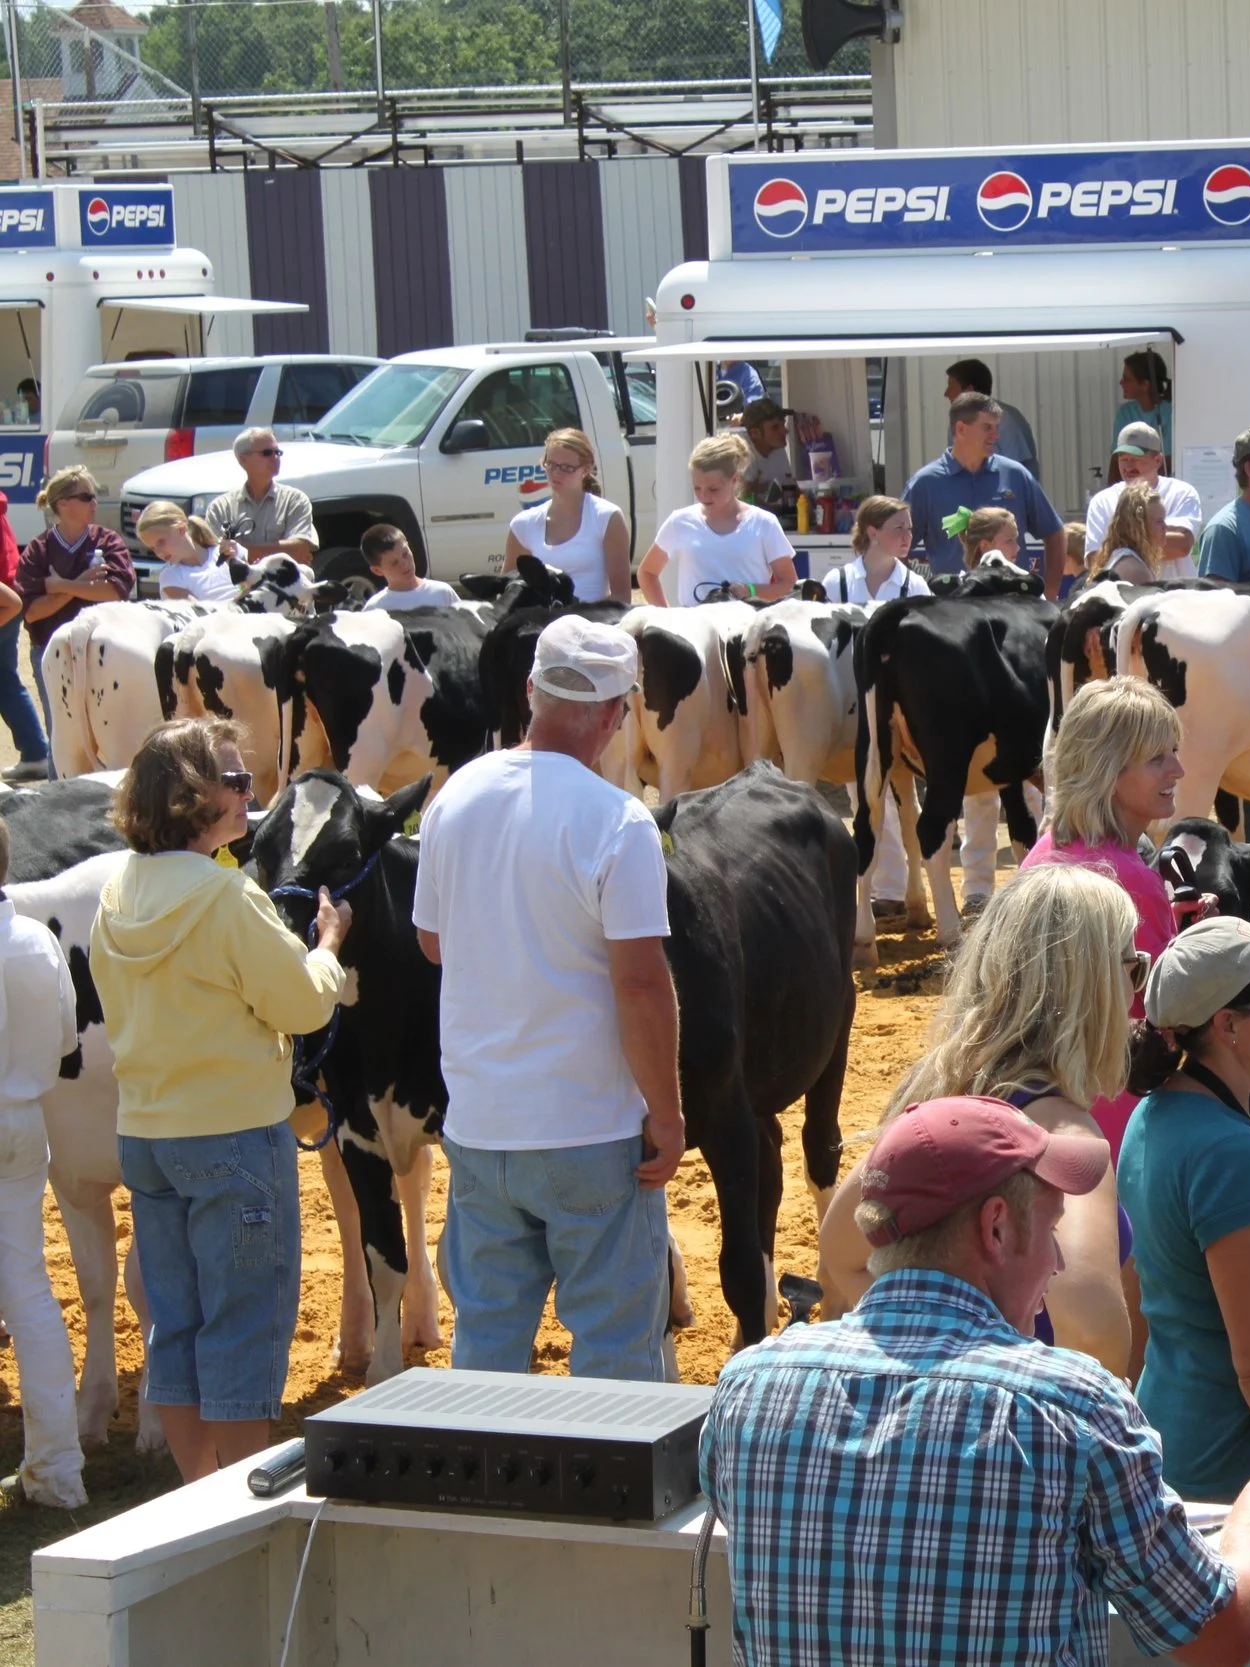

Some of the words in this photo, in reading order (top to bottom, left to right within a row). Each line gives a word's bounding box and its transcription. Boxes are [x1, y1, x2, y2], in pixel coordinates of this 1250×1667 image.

[812, 186, 950, 225] PEPSI
[1037, 179, 1178, 218] PEPSI
[111, 204, 166, 228] PEPSI
[485, 465, 548, 485] PEPS
